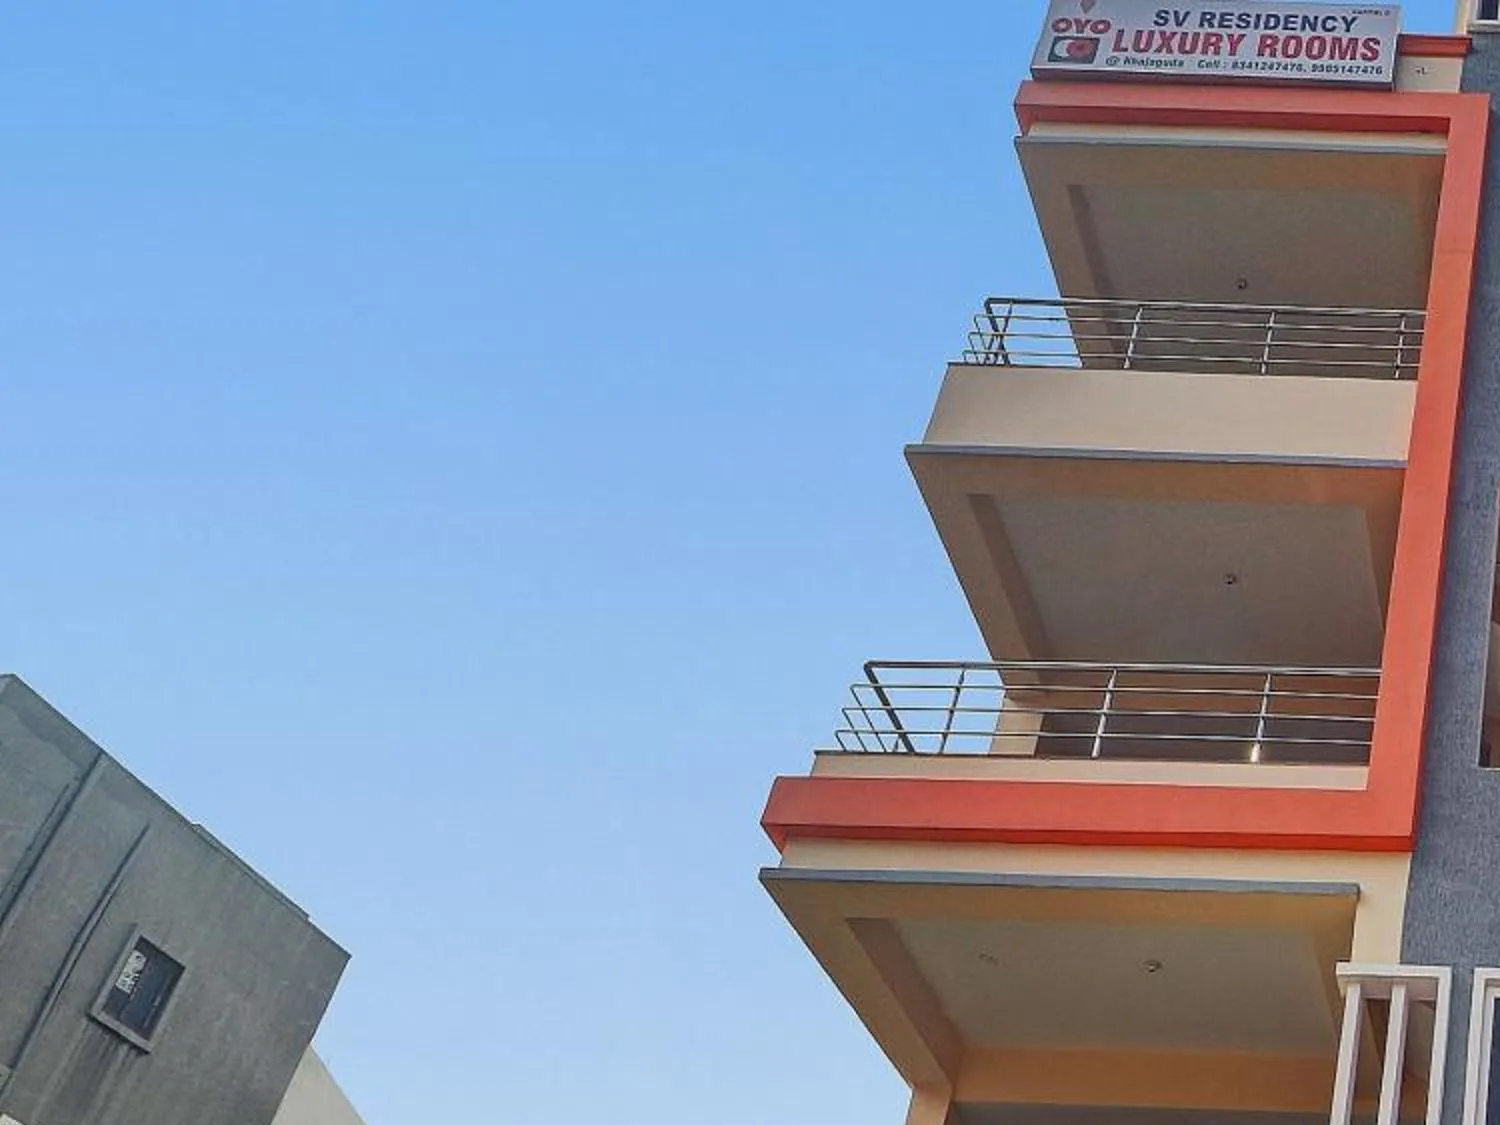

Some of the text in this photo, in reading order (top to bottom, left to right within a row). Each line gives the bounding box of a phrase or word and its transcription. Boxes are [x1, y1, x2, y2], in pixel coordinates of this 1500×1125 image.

[1052, 18, 1111, 34] OYO
[1153, 10, 1358, 33] SV RESIDENCY
[1112, 28, 1381, 61] LUXURY ROOMS
